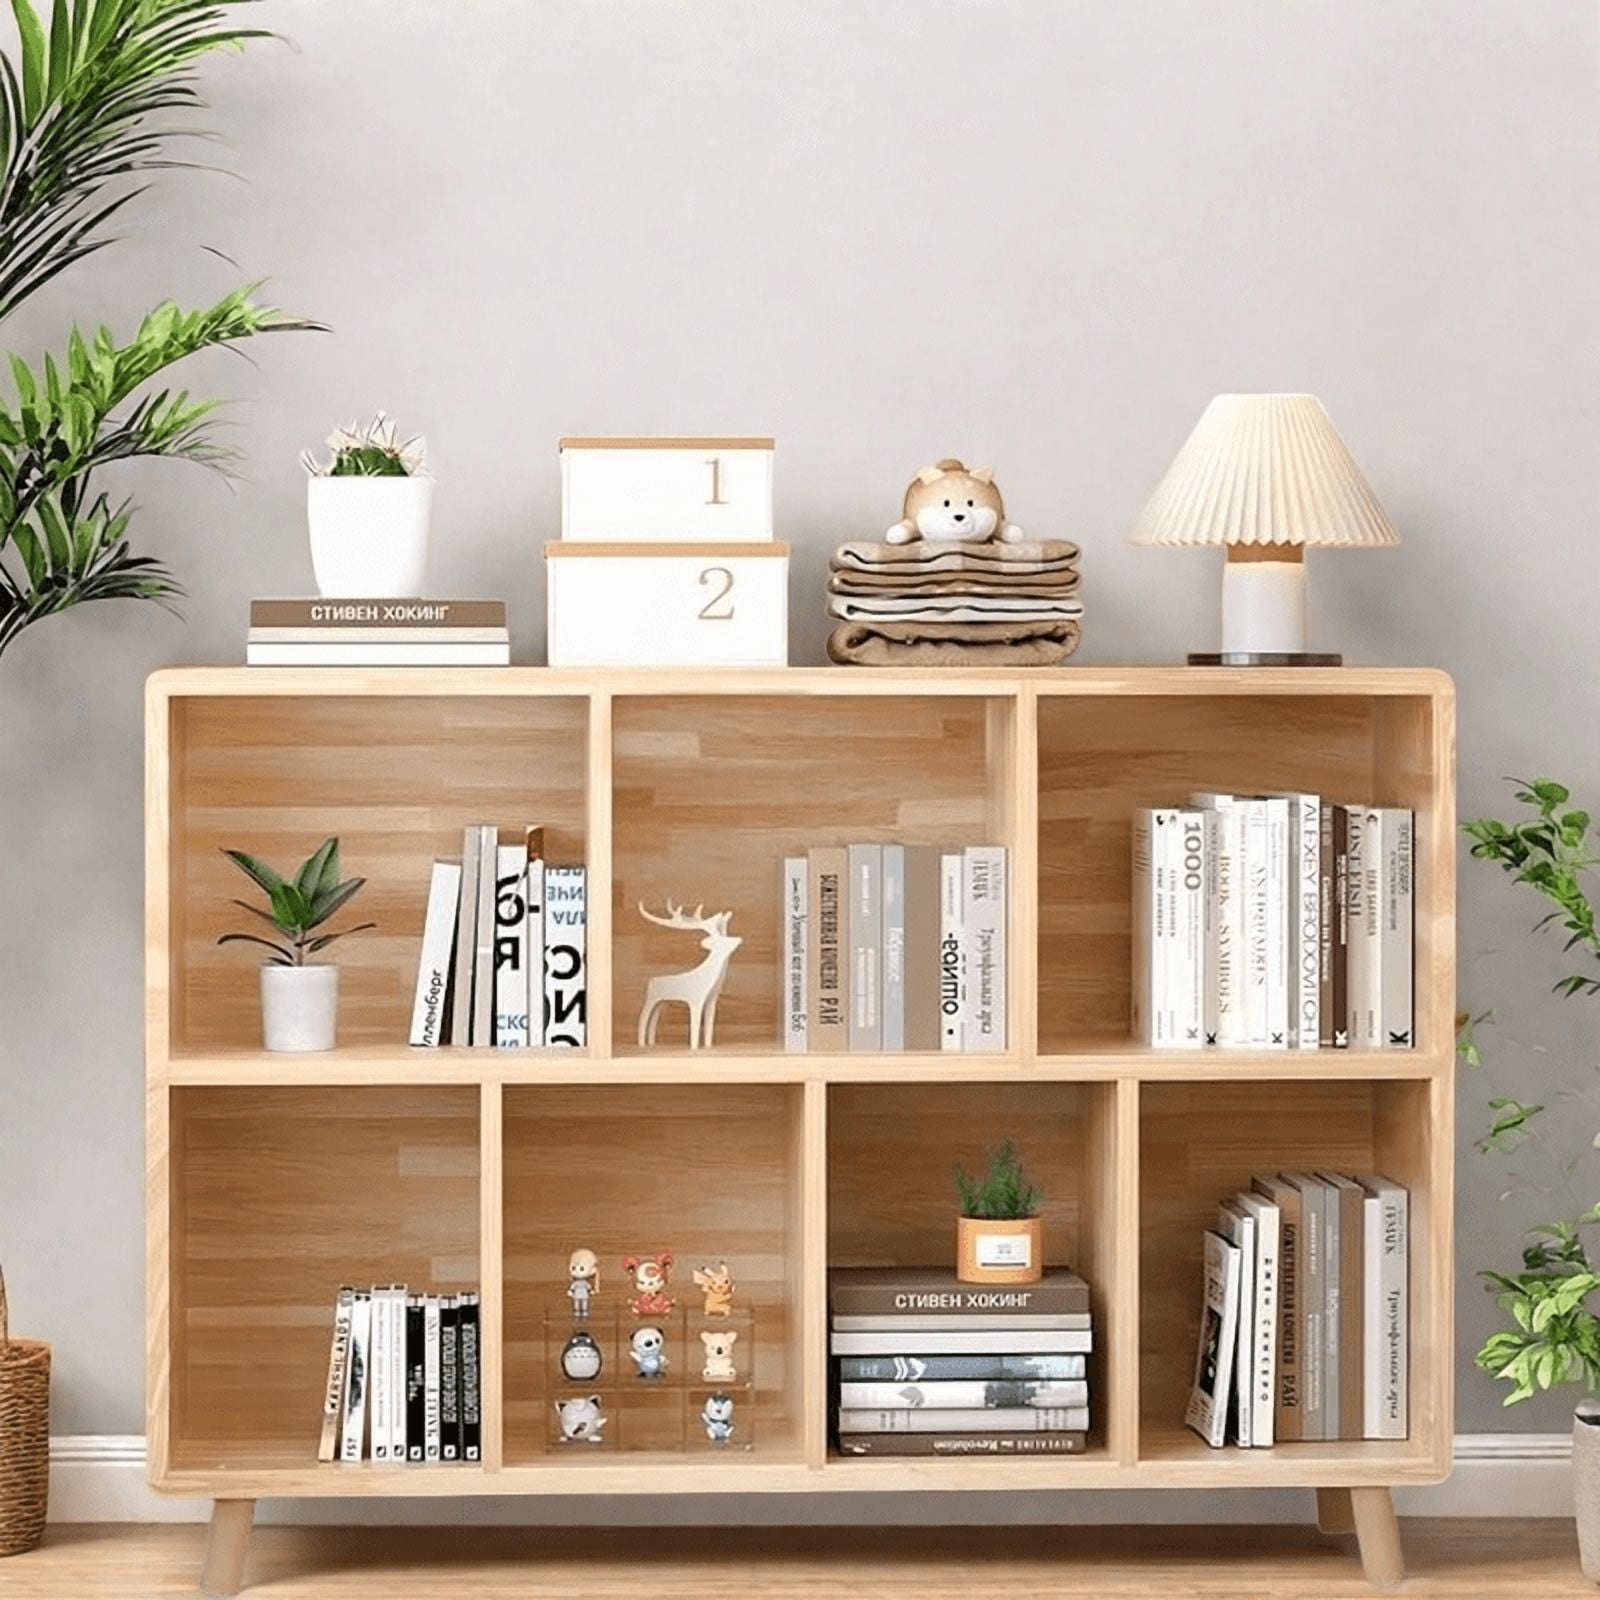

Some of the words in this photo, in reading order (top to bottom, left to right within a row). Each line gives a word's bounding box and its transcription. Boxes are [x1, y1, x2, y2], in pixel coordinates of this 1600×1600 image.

[703, 458, 730, 505] 1
[310, 604, 379, 621] СТИВЕН
[382, 604, 449, 622] ХОКИНГ
[697, 567, 736, 620] 2
[1184, 821, 1203, 891] 1000
[1348, 812, 1363, 865] LOST
[1348, 871, 1363, 917] FISH
[820, 996, 843, 1025] РАЙ
[895, 1293, 962, 1309] СТИВЕН
[966, 1292, 1032, 1308] ХОКИНГ
[1281, 1374, 1299, 1408] РАЙ
